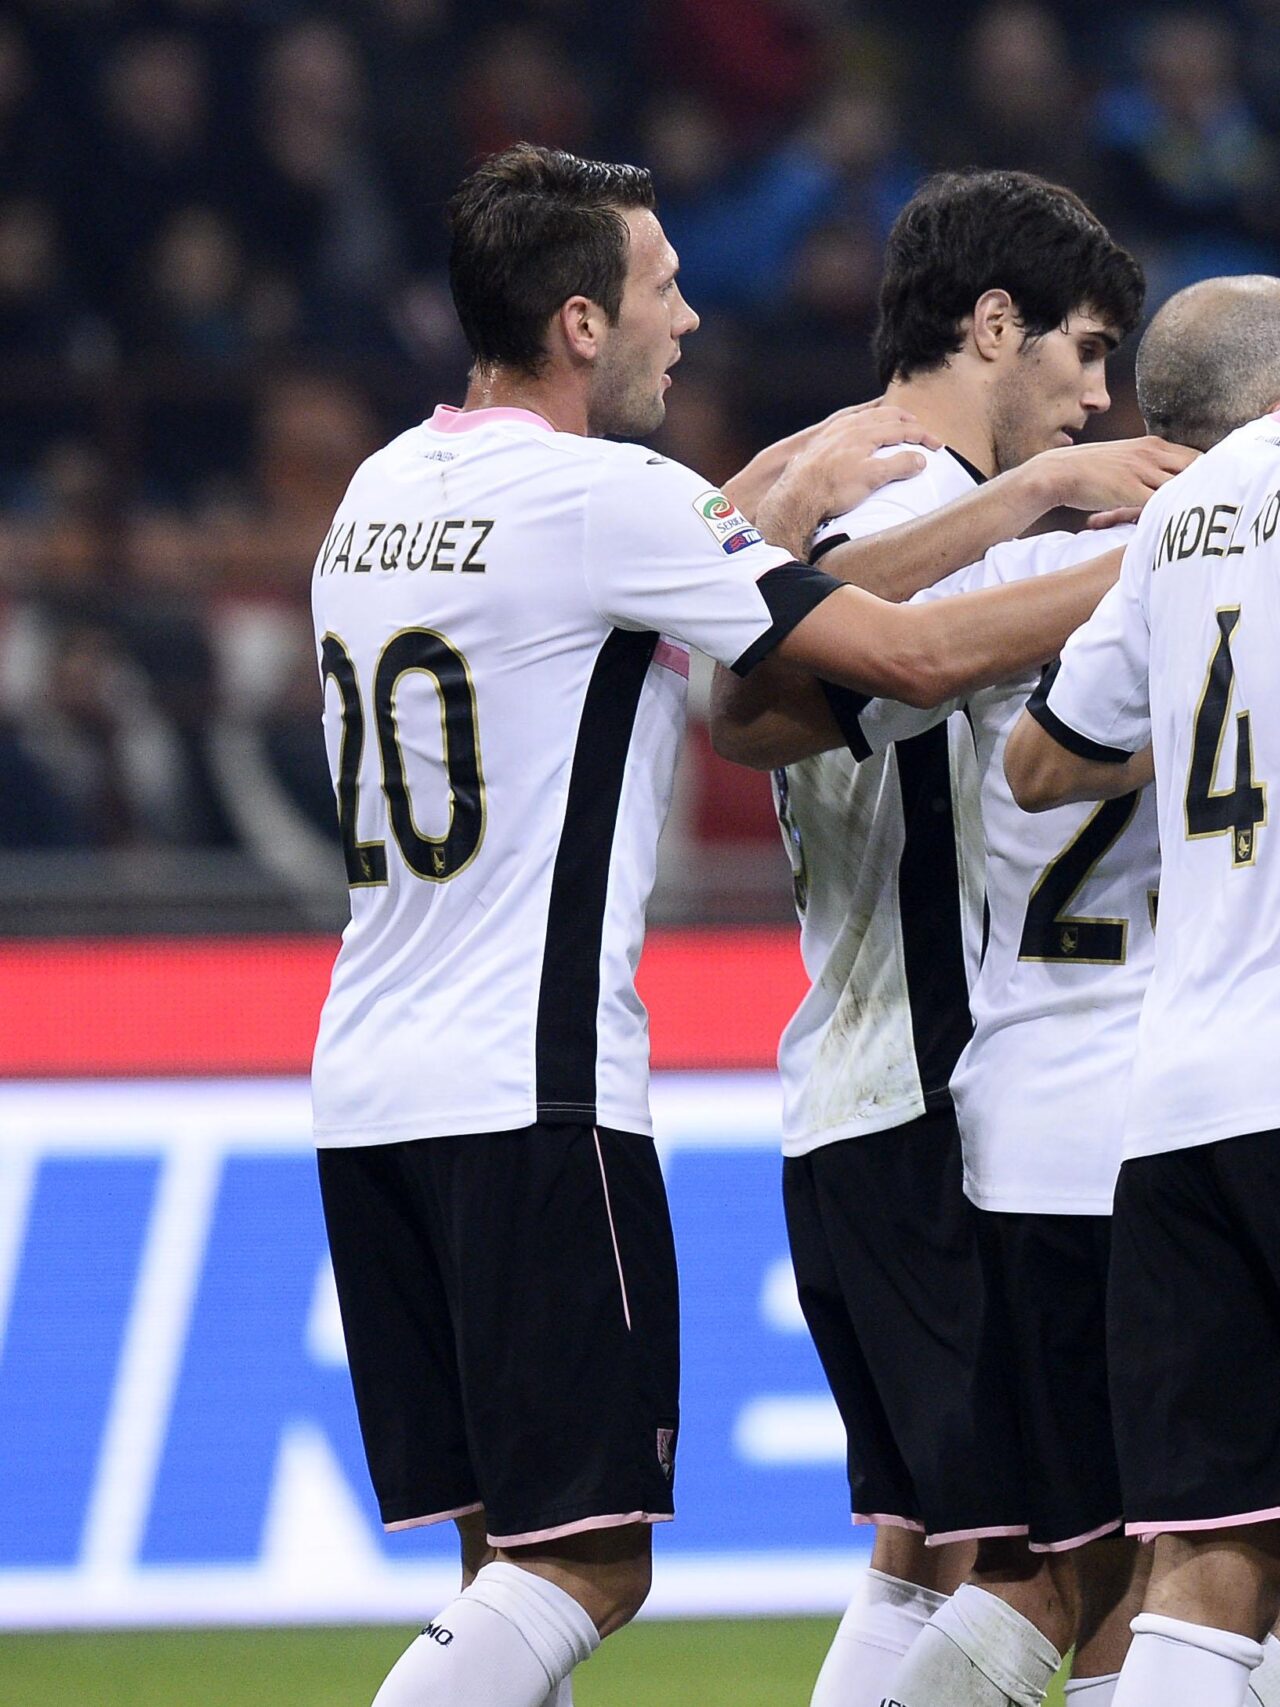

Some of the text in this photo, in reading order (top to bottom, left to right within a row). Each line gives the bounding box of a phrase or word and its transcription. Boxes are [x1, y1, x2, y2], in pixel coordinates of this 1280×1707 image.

[320, 520, 496, 577] VAZQUEZ
[321, 626, 487, 888] 20
[1185, 603, 1268, 868] 4
[1018, 791, 1159, 965] 2
